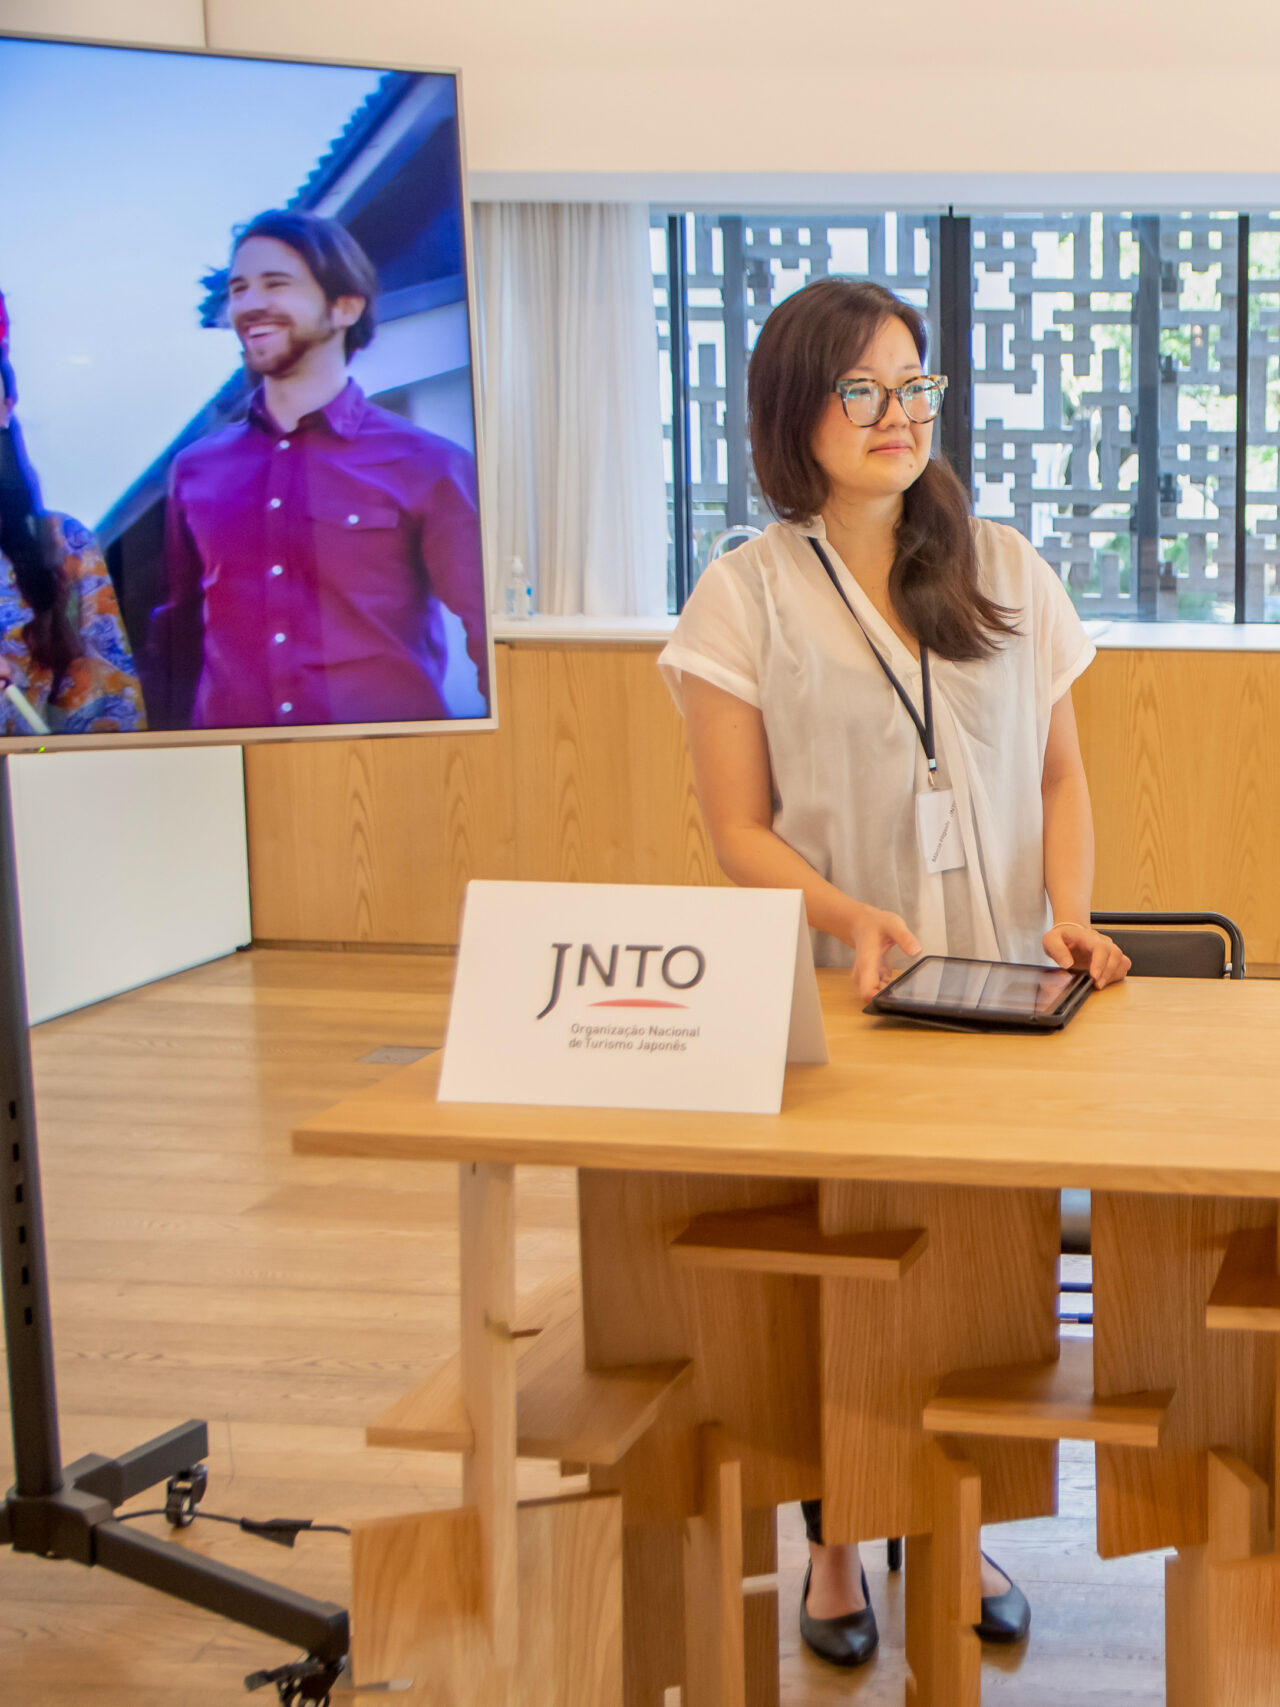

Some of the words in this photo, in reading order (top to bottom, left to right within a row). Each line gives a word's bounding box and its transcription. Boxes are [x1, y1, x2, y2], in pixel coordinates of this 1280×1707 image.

[536, 942, 706, 1020] JNTO
[571, 1022, 646, 1038] Organização
[648, 1025, 701, 1038] Nacional
[568, 1037, 583, 1049] de
[585, 1037, 634, 1050] Turismo
[636, 1038, 687, 1053] Japonês
